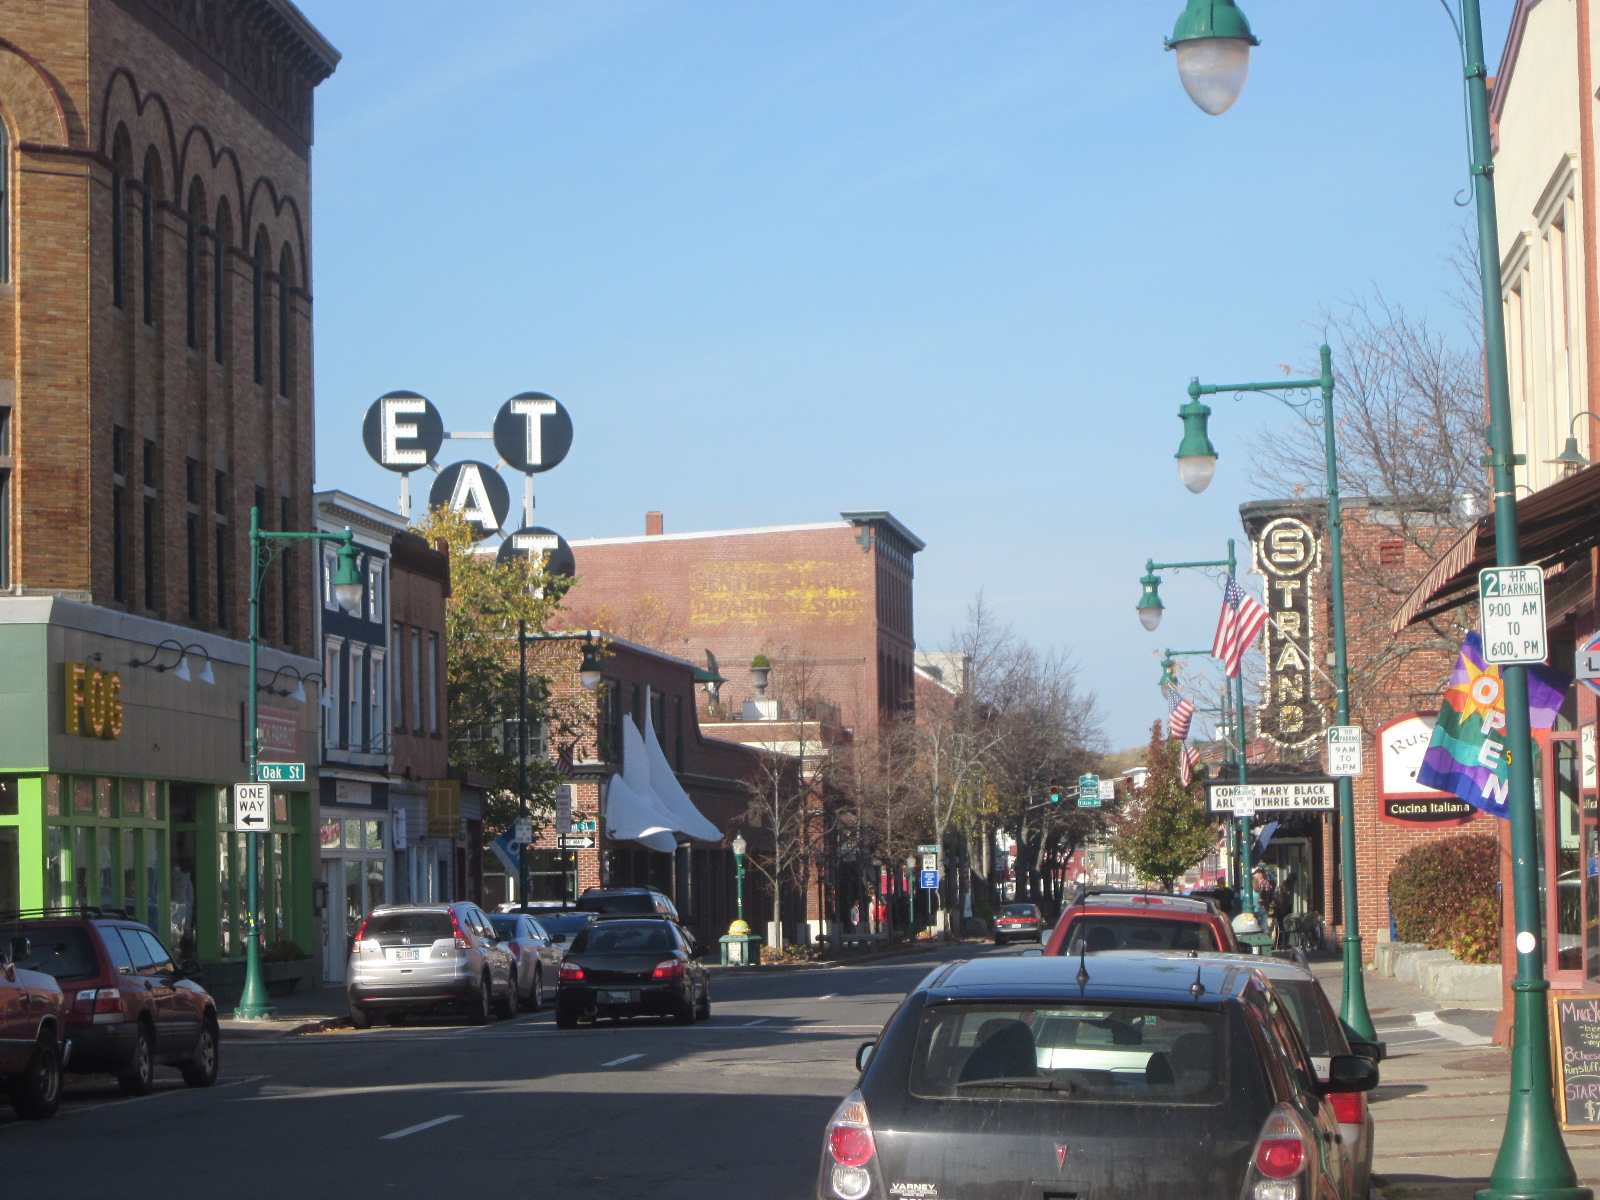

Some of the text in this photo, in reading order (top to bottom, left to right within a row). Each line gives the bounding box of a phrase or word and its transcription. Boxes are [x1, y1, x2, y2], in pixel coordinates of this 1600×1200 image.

[1485, 571, 1526, 596] 2 HR
[1501, 582, 1539, 595] PARKING
[1488, 602, 1537, 617] 9:00 AM
[1270, 528, 1306, 734] STRAND
[1508, 622, 1520, 635] TO
[1491, 640, 1539, 656] 6:00 PM
[65, 662, 123, 740] FOG
[1330, 730, 1338, 742] 2
[1472, 676, 1509, 805] OPEN
[1390, 732, 1431, 755] Rus
[262, 766, 300, 779] Oak St
[240, 788, 264, 798] ONE
[1261, 787, 1288, 795] MARY
[1295, 785, 1326, 795] BLACK
[240, 801, 264, 811] WAY
[1254, 797, 1290, 807] UTHRIE
[1302, 796, 1330, 805] MORE
[1391, 802, 1470, 813] Cucina Italiana
[1562, 1002, 1594, 1022] MAKE
